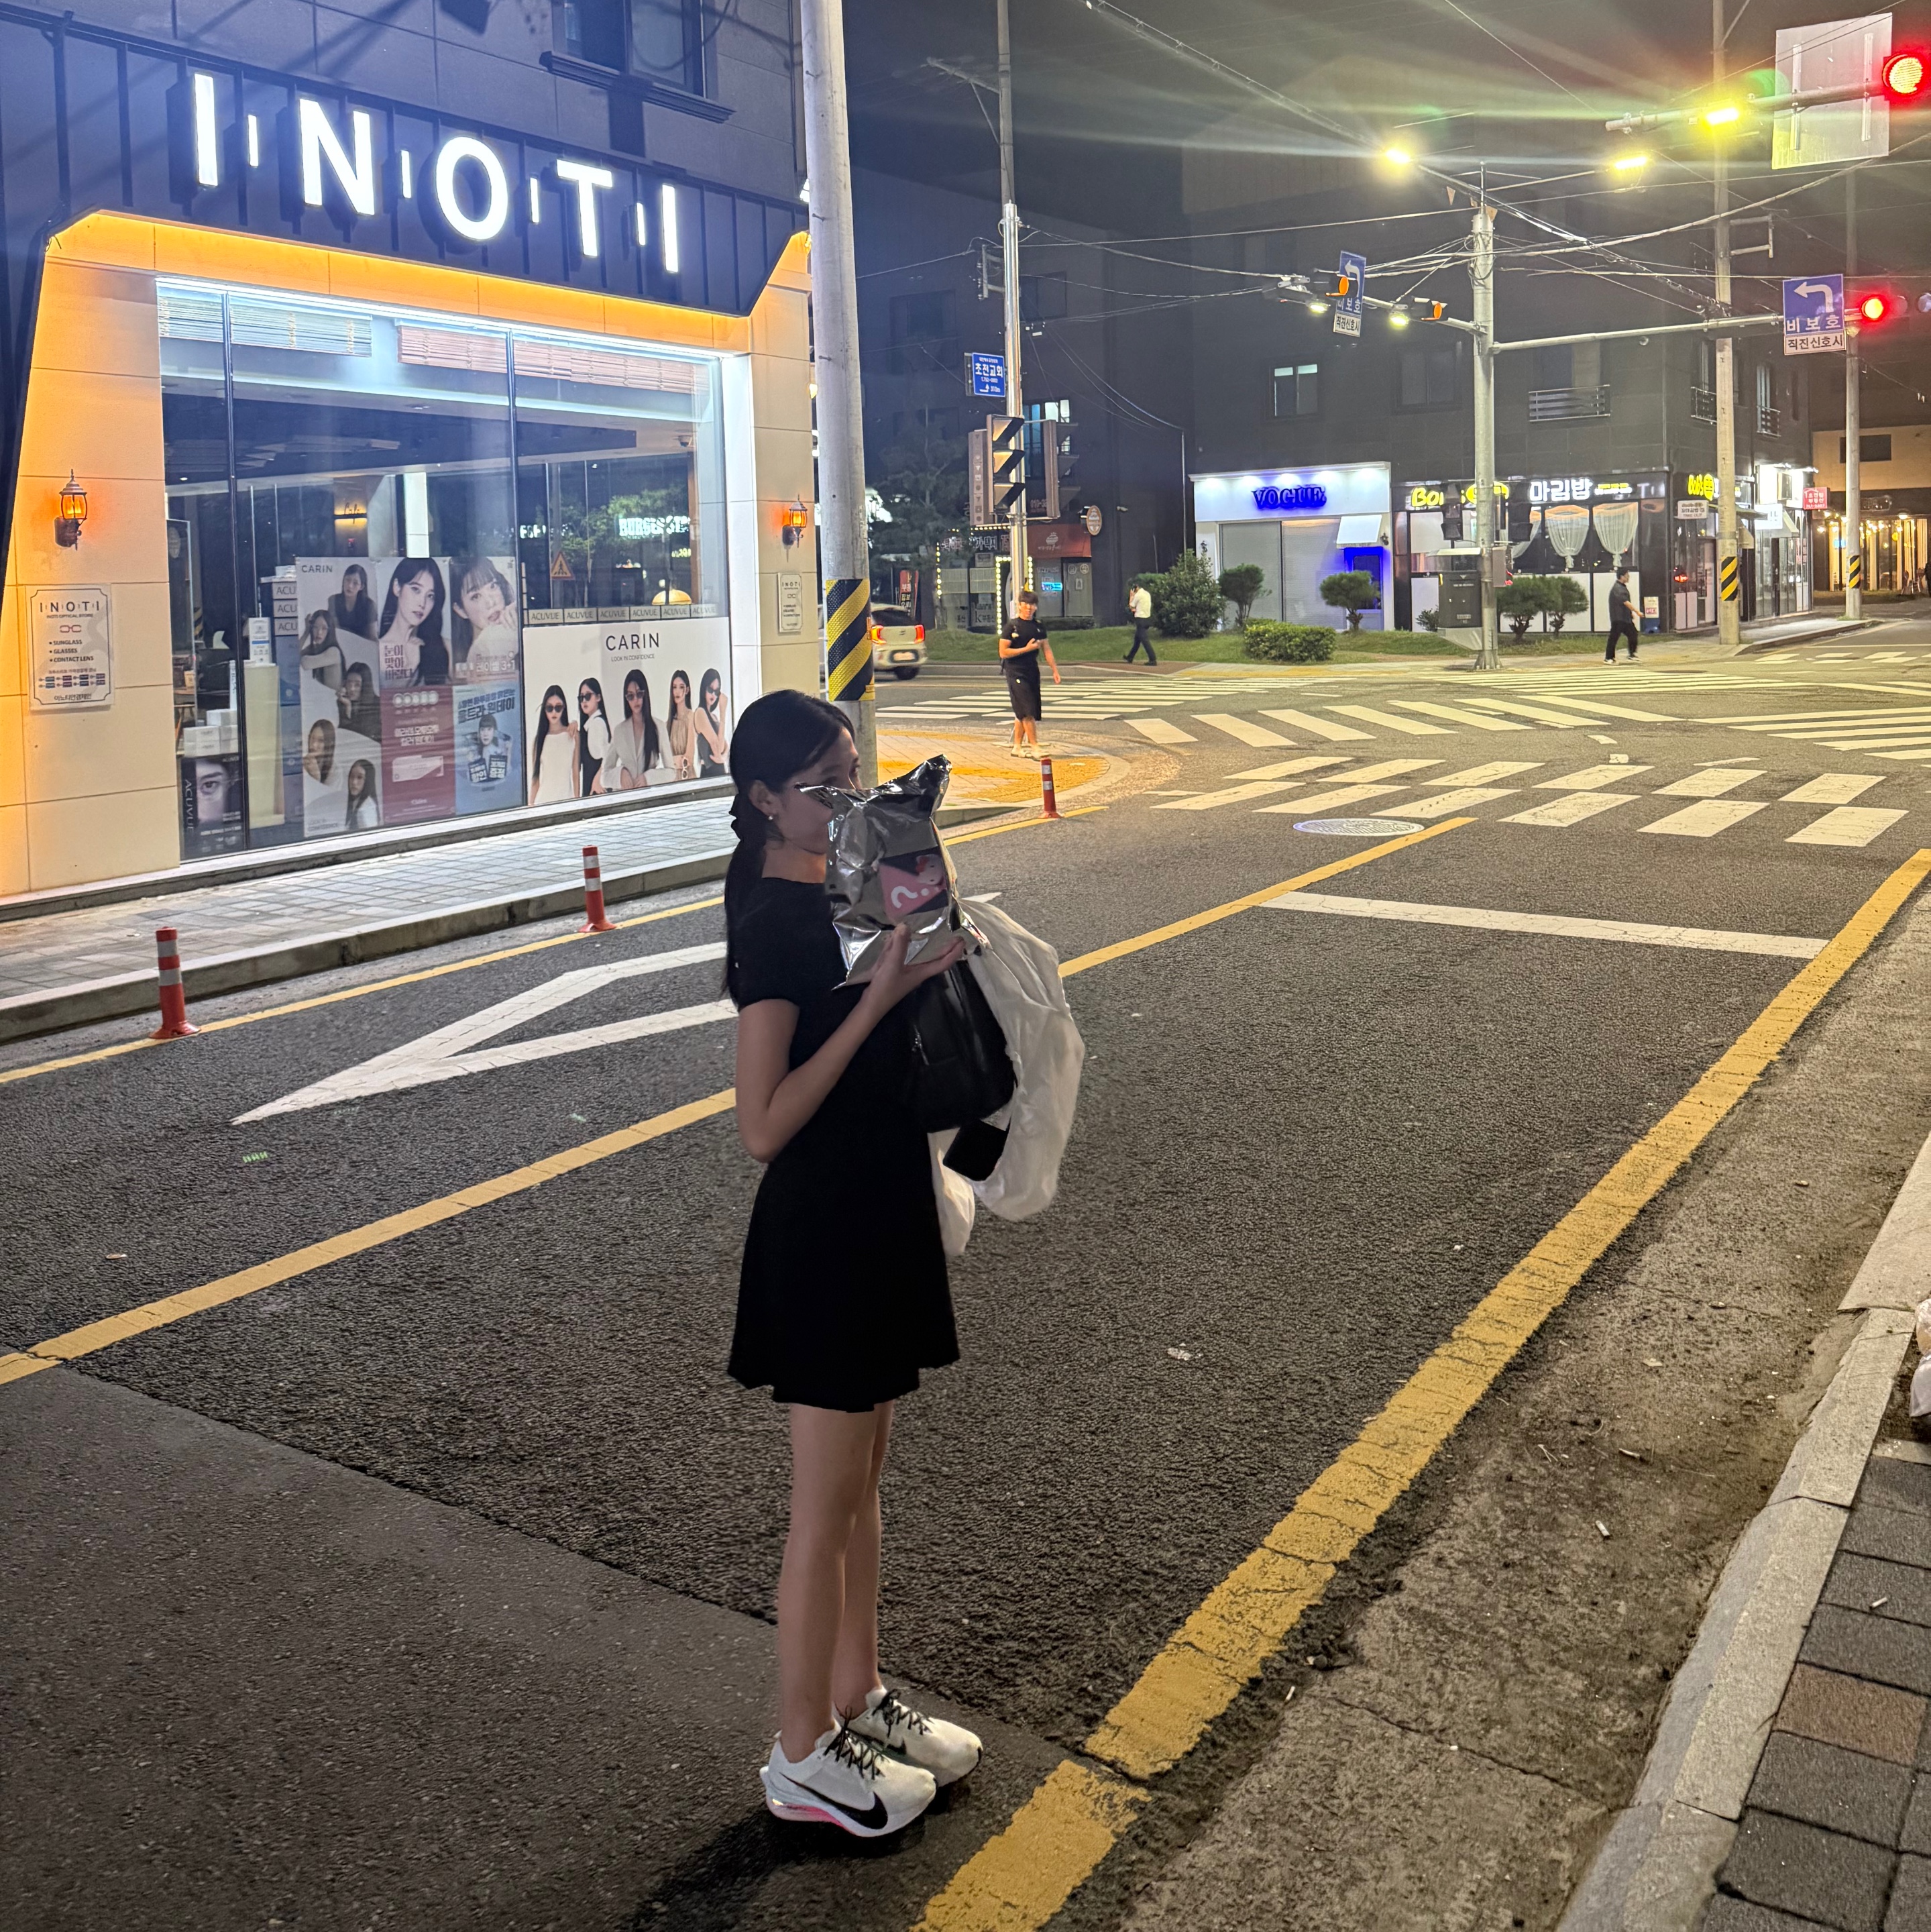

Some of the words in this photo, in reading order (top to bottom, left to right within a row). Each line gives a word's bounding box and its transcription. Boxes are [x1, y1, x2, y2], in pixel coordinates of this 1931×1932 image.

[1336, 316, 1359, 331] 직진신호시
[1786, 315, 1841, 333] 비보호
[1787, 334, 1842, 350] 직진신호시
[975, 362, 1003, 378] 초전교회
[1529, 477, 1594, 502] 마김밥
[1251, 486, 1327, 509] VOGUE
[302, 565, 333, 573] CARIN
[276, 586, 296, 595] ACU
[40, 600, 100, 612] INOTI
[278, 604, 297, 612] ACU
[632, 608, 658, 616] ACUVUE
[663, 607, 687, 615] ACUVUE
[531, 612, 559, 621] ACUVUE
[567, 611, 594, 619] ACUVUE
[600, 610, 626, 618] ACUVUE
[278, 622, 298, 631] ACU
[606, 633, 659, 651] CARIN
[385, 645, 403, 657] 눈이
[385, 657, 404, 669] 맞아
[501, 660, 516, 671] 3+1
[488, 696, 515, 715] 원데이
[184, 778, 195, 833] ACUVUE
